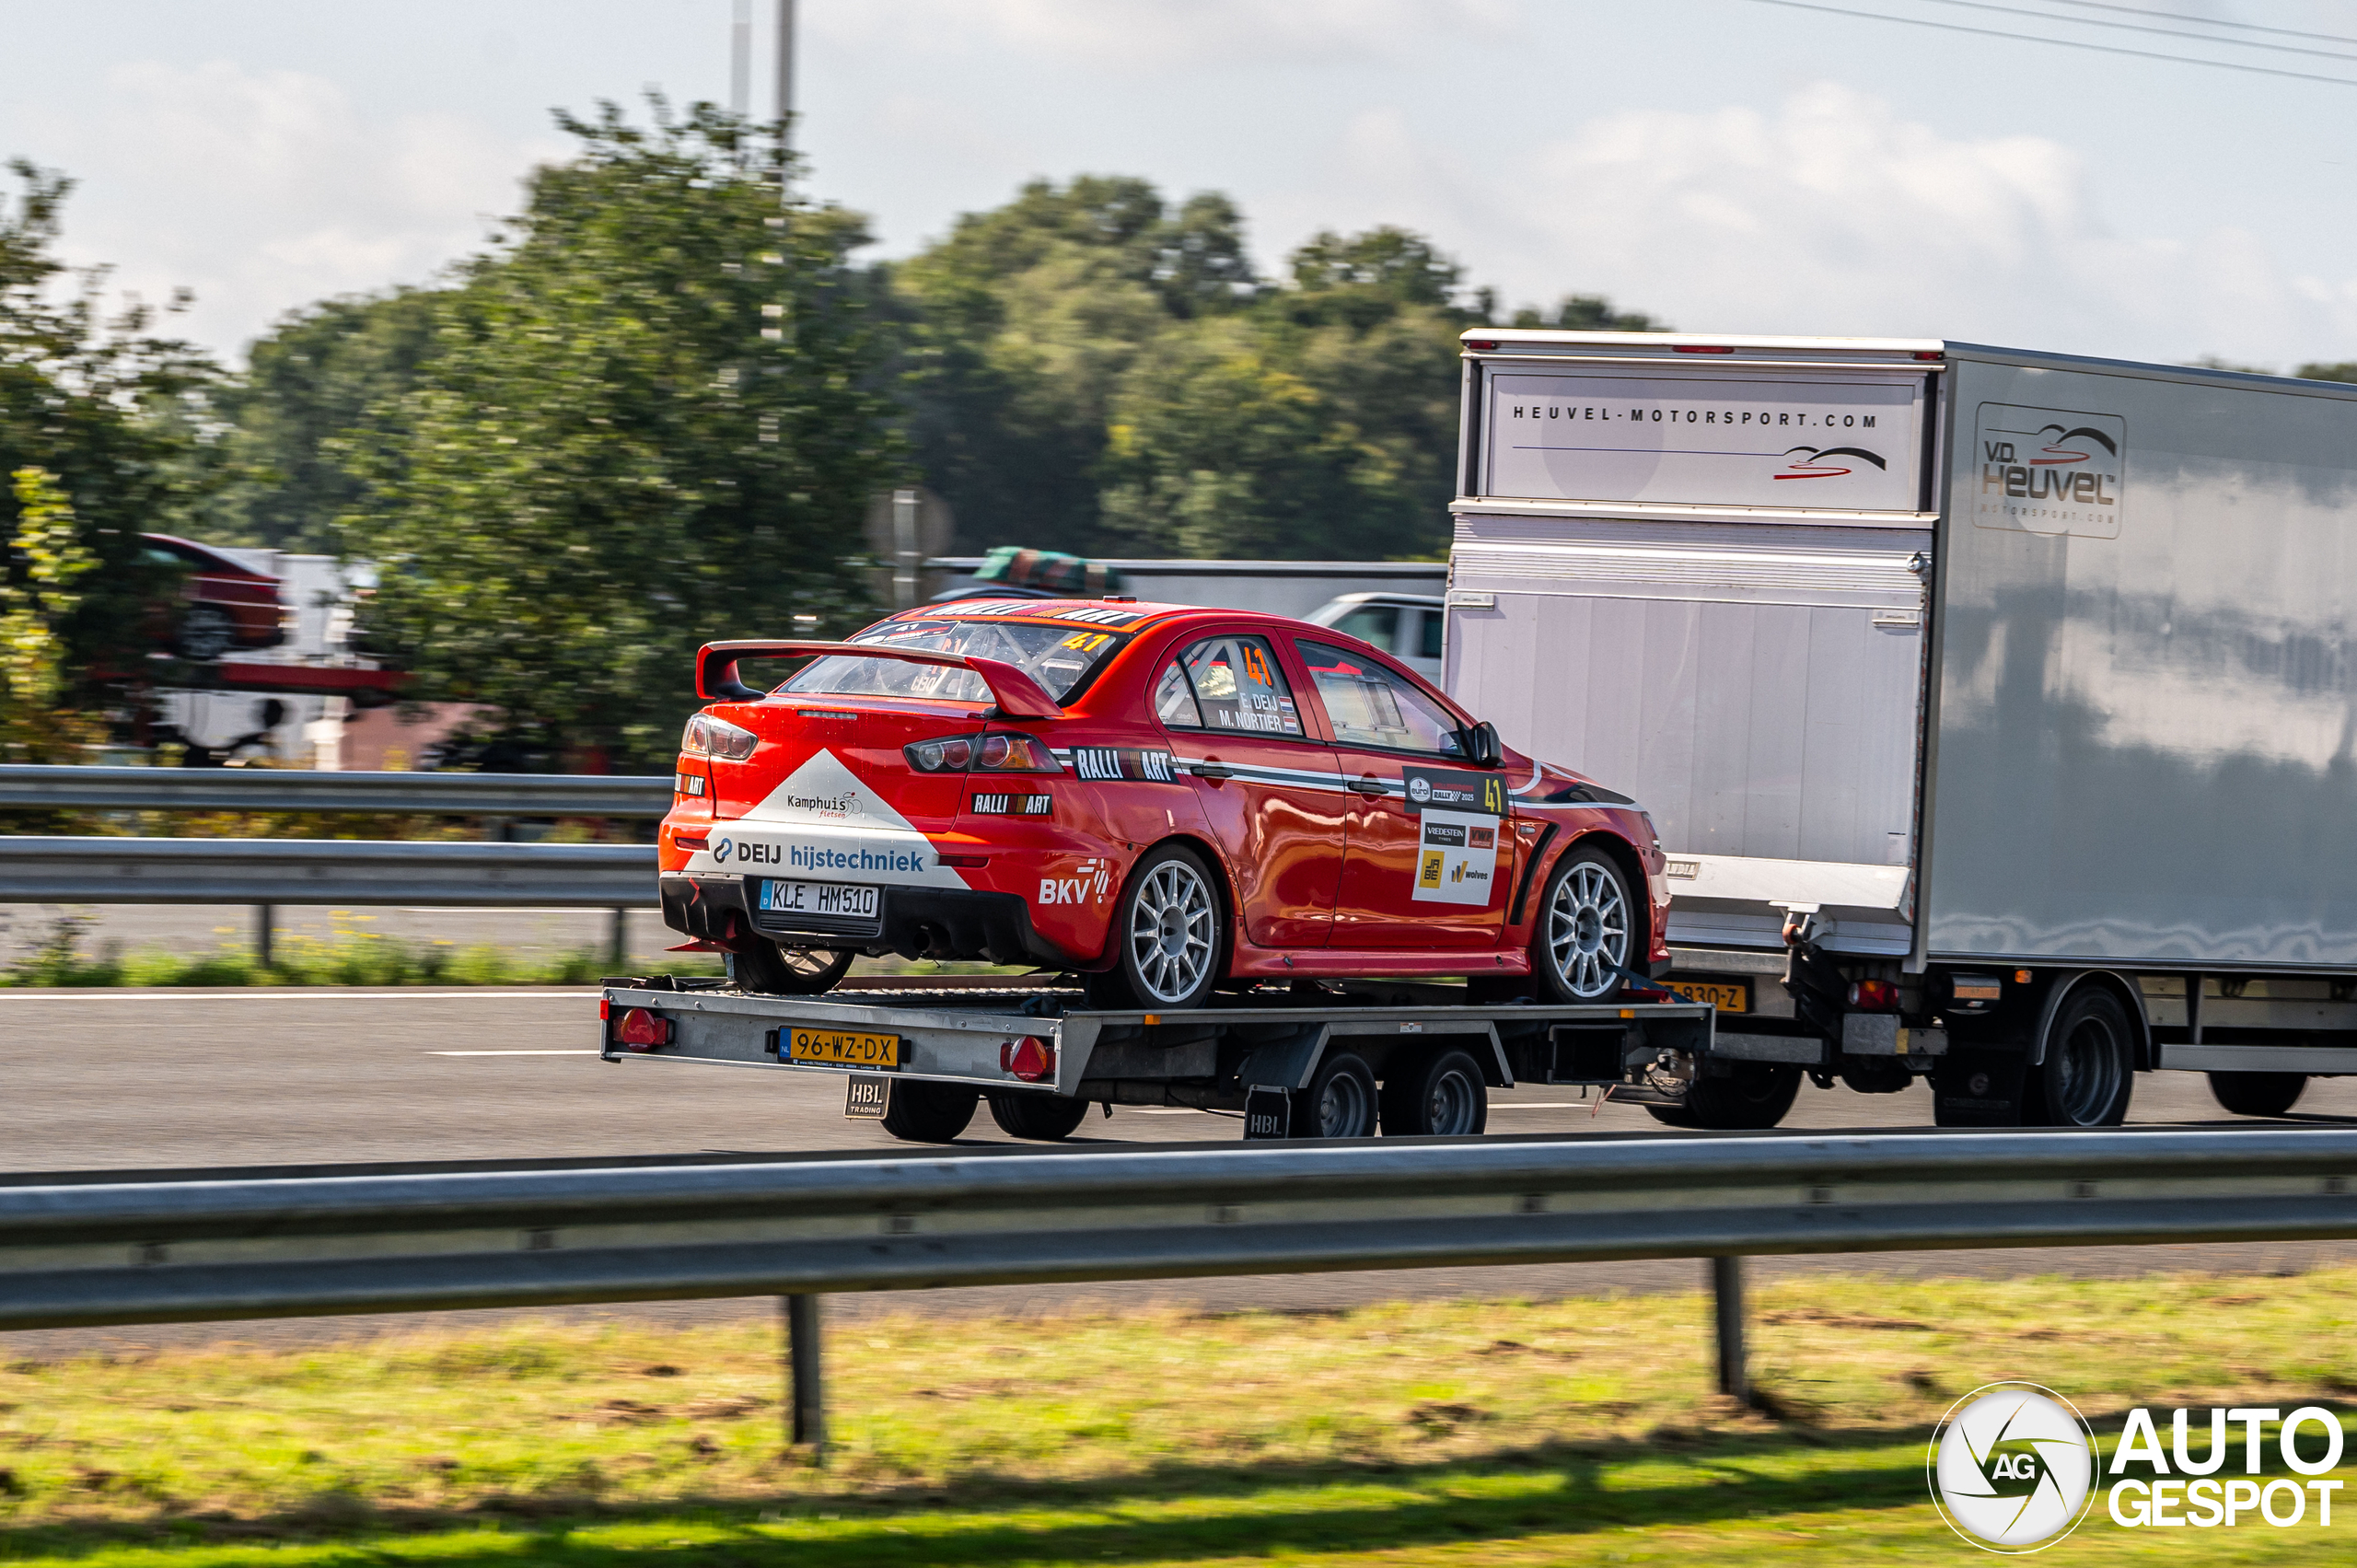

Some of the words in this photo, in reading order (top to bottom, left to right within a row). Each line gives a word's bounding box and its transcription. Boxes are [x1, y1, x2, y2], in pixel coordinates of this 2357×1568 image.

[1513, 406, 1876, 428] HEUVEL-MOTORSPORT.COM
[1984, 441, 2017, 463] V.D.
[1981, 504, 2114, 523] MOTORSPORT.COM
[923, 604, 1039, 616] RALLI
[1052, 608, 1144, 623] ART
[1062, 632, 1109, 652] 41
[1244, 646, 1272, 686] 41
[1239, 692, 1252, 709] E.
[1252, 693, 1278, 711] DEIJ
[1218, 709, 1235, 726] M.
[1235, 711, 1283, 731] NORTIER
[1076, 749, 1124, 779] RALLI
[1141, 751, 1172, 782] ART
[688, 776, 704, 796] ART
[1411, 787, 1429, 796] eurol
[1484, 778, 1502, 812] 41
[787, 795, 846, 811] Kamphuis
[974, 795, 1009, 813] RALLI
[1025, 796, 1050, 814] ART
[819, 810, 846, 819] fietsen
[1427, 827, 1464, 837] VREDESTEIN
[1470, 830, 1492, 841] VWP
[738, 842, 781, 865] DEIJ
[791, 845, 924, 872] hijstechniek
[1465, 870, 1488, 880] wolves
[772, 883, 806, 910] KLE
[1038, 878, 1090, 904] BKV
[797, 1033, 891, 1062] 96-WZ-DX
[852, 1084, 882, 1104] HBL
[851, 1106, 881, 1114] TRADING
[1250, 1114, 1282, 1134] HBL
